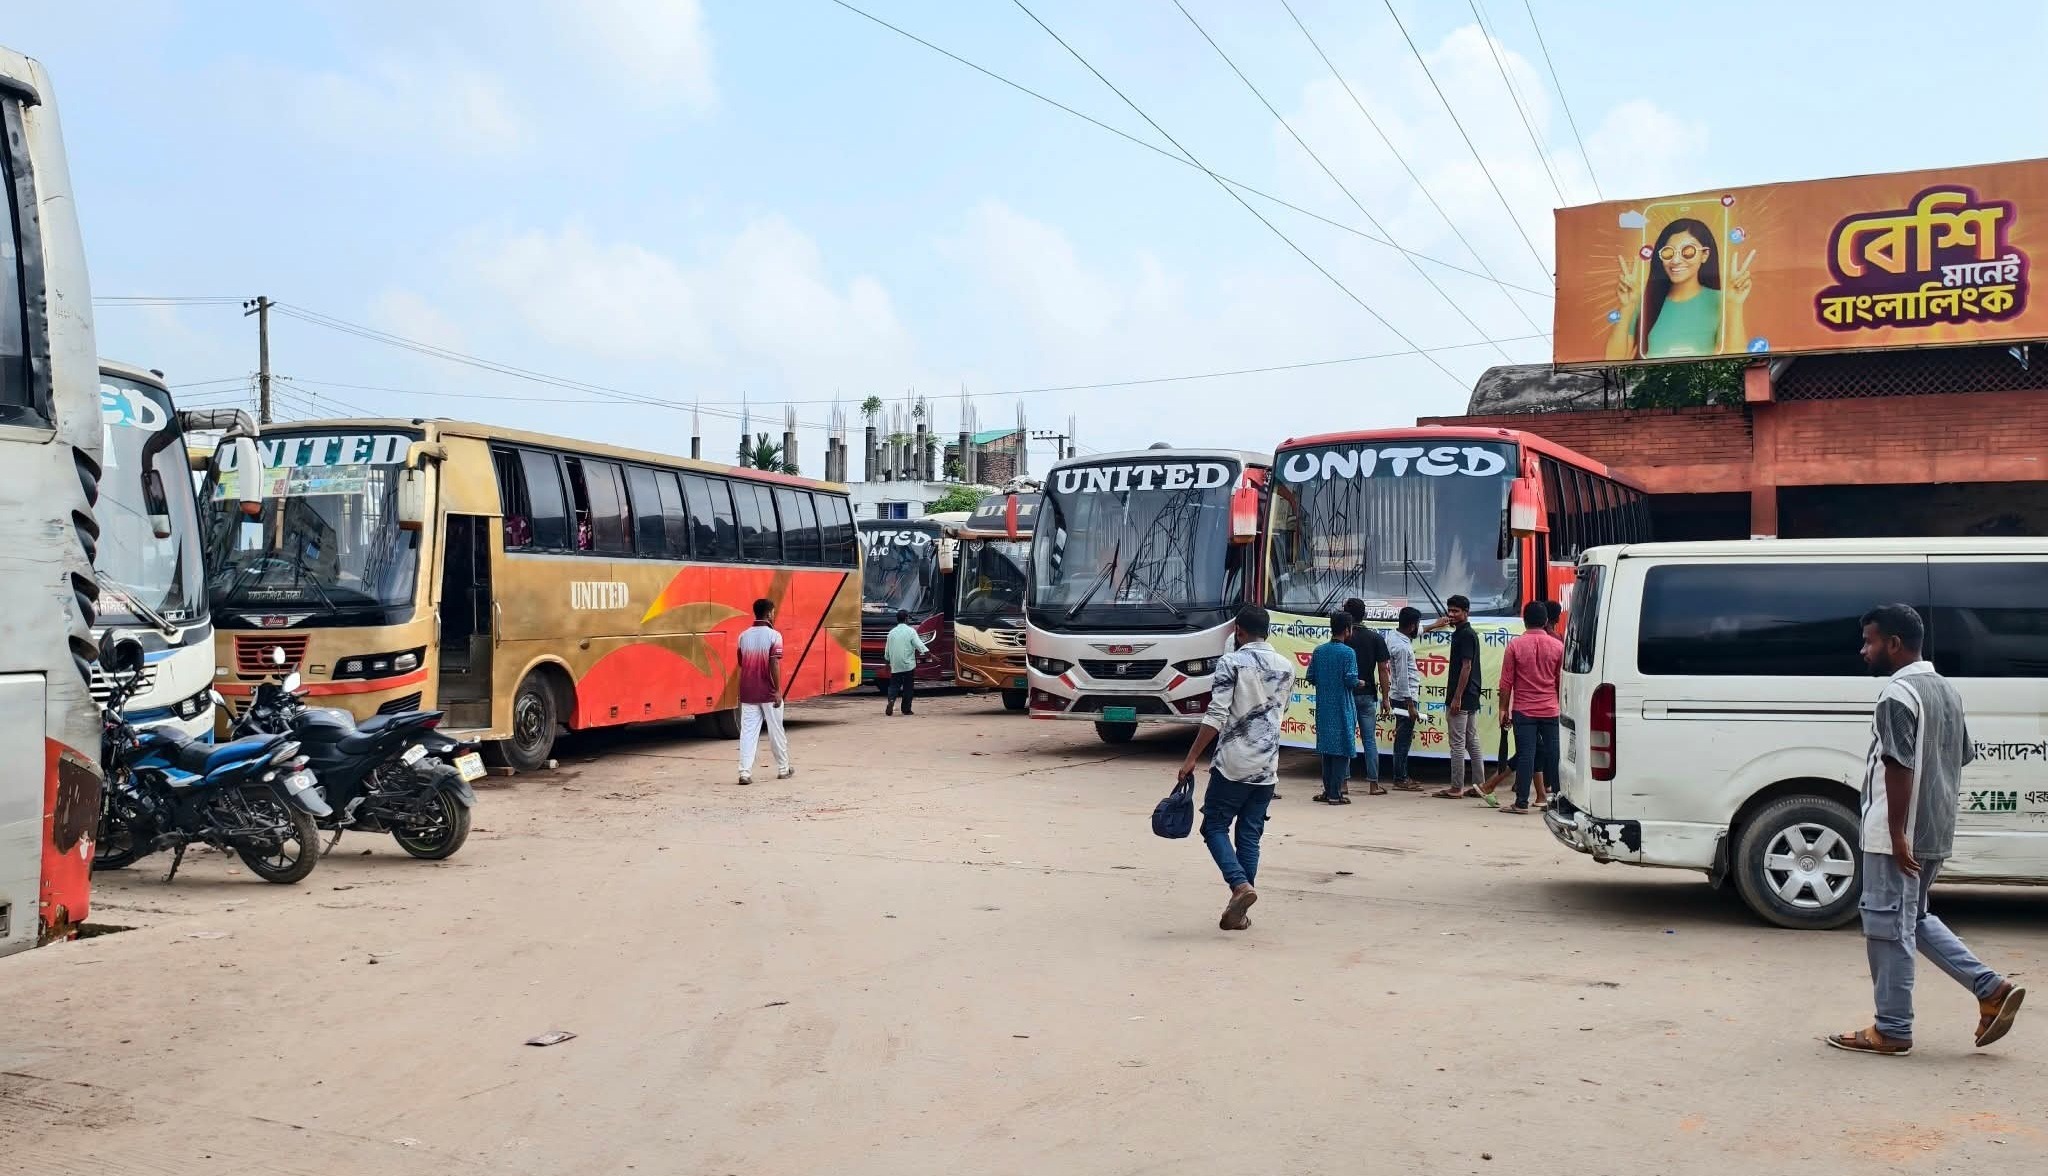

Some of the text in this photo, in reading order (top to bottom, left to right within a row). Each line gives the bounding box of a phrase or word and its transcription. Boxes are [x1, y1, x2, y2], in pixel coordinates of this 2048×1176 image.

[1838, 191, 2003, 277] বেশি
[1940, 254, 2020, 287] মানেই
[1821, 282, 2016, 324] বাংলালিংক
[1056, 463, 1230, 494] UNITED
[1284, 446, 1507, 483] UNITED
[857, 530, 931, 548] NITED
[570, 581, 629, 610] UNITED
[1974, 740, 2048, 761] াংলাদেশ
[1969, 790, 2017, 811] XIM
